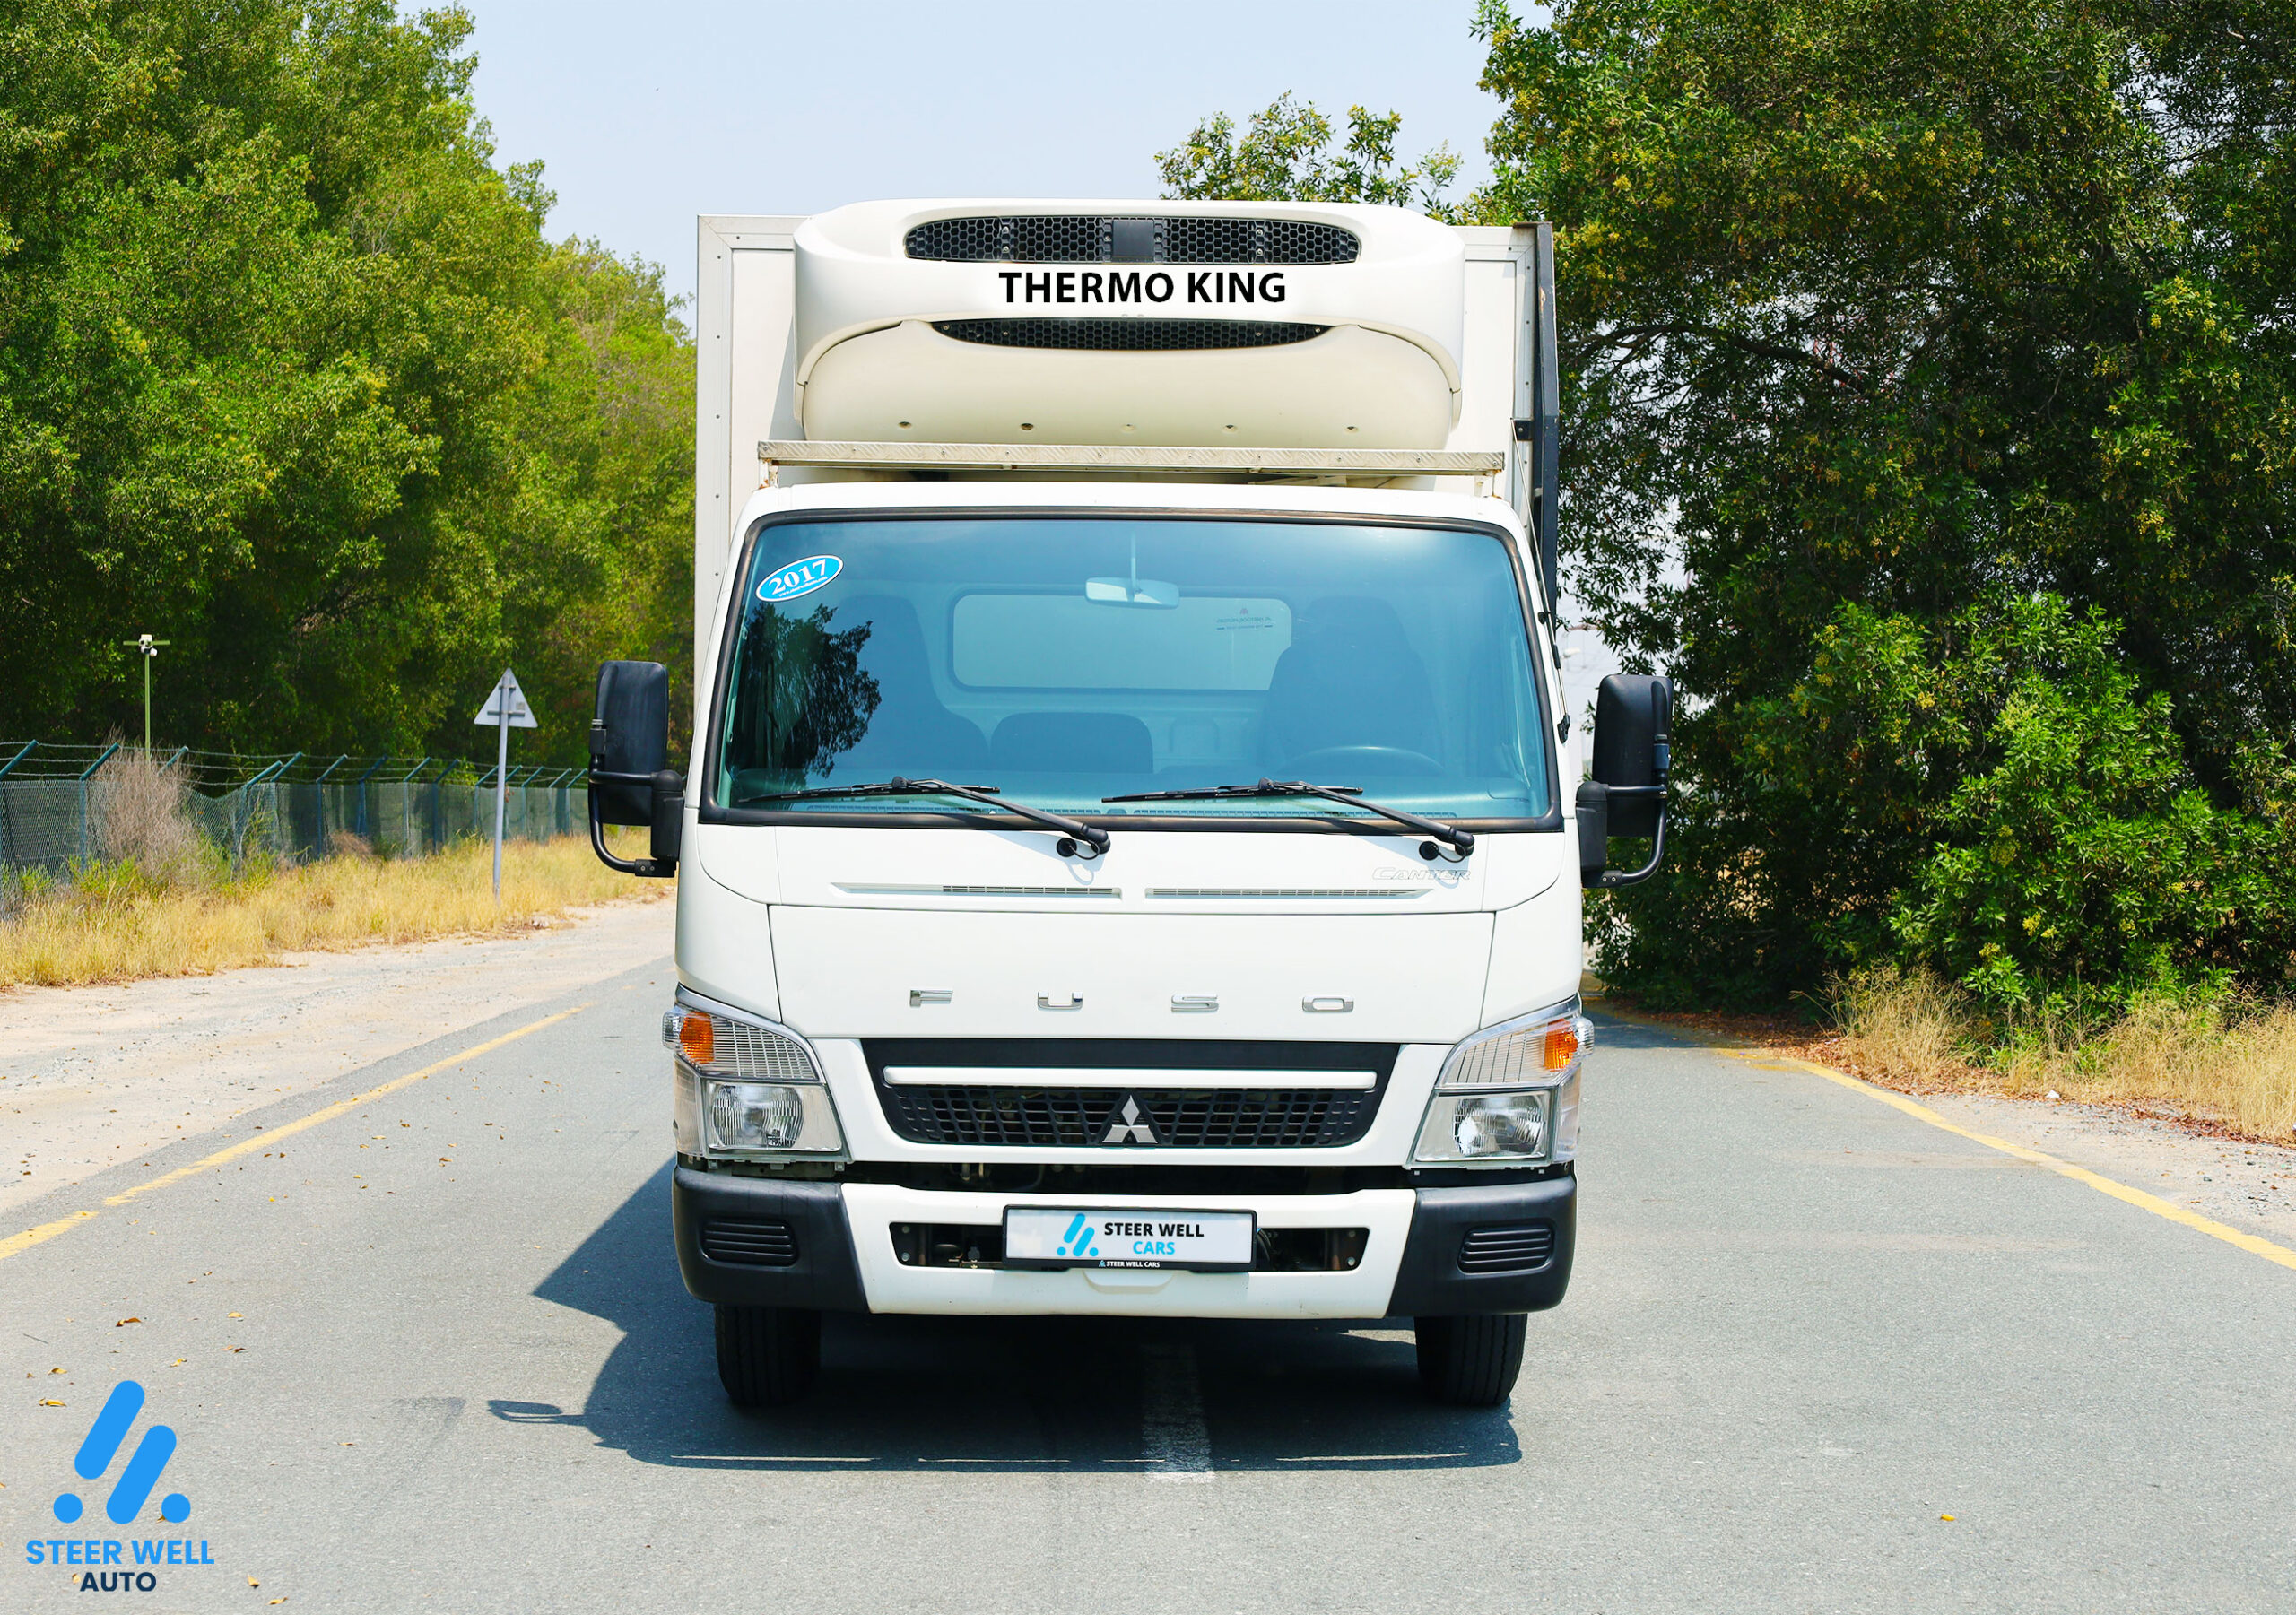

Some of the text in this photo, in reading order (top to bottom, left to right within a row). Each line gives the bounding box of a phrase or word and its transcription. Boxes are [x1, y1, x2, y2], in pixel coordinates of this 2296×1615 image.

[998, 272, 1285, 303] THERMO KING
[768, 558, 826, 595] 2017
[909, 989, 1355, 1013] FUSO
[1104, 1222, 1205, 1237] STEER WELL
[1133, 1240, 1176, 1255] CARS
